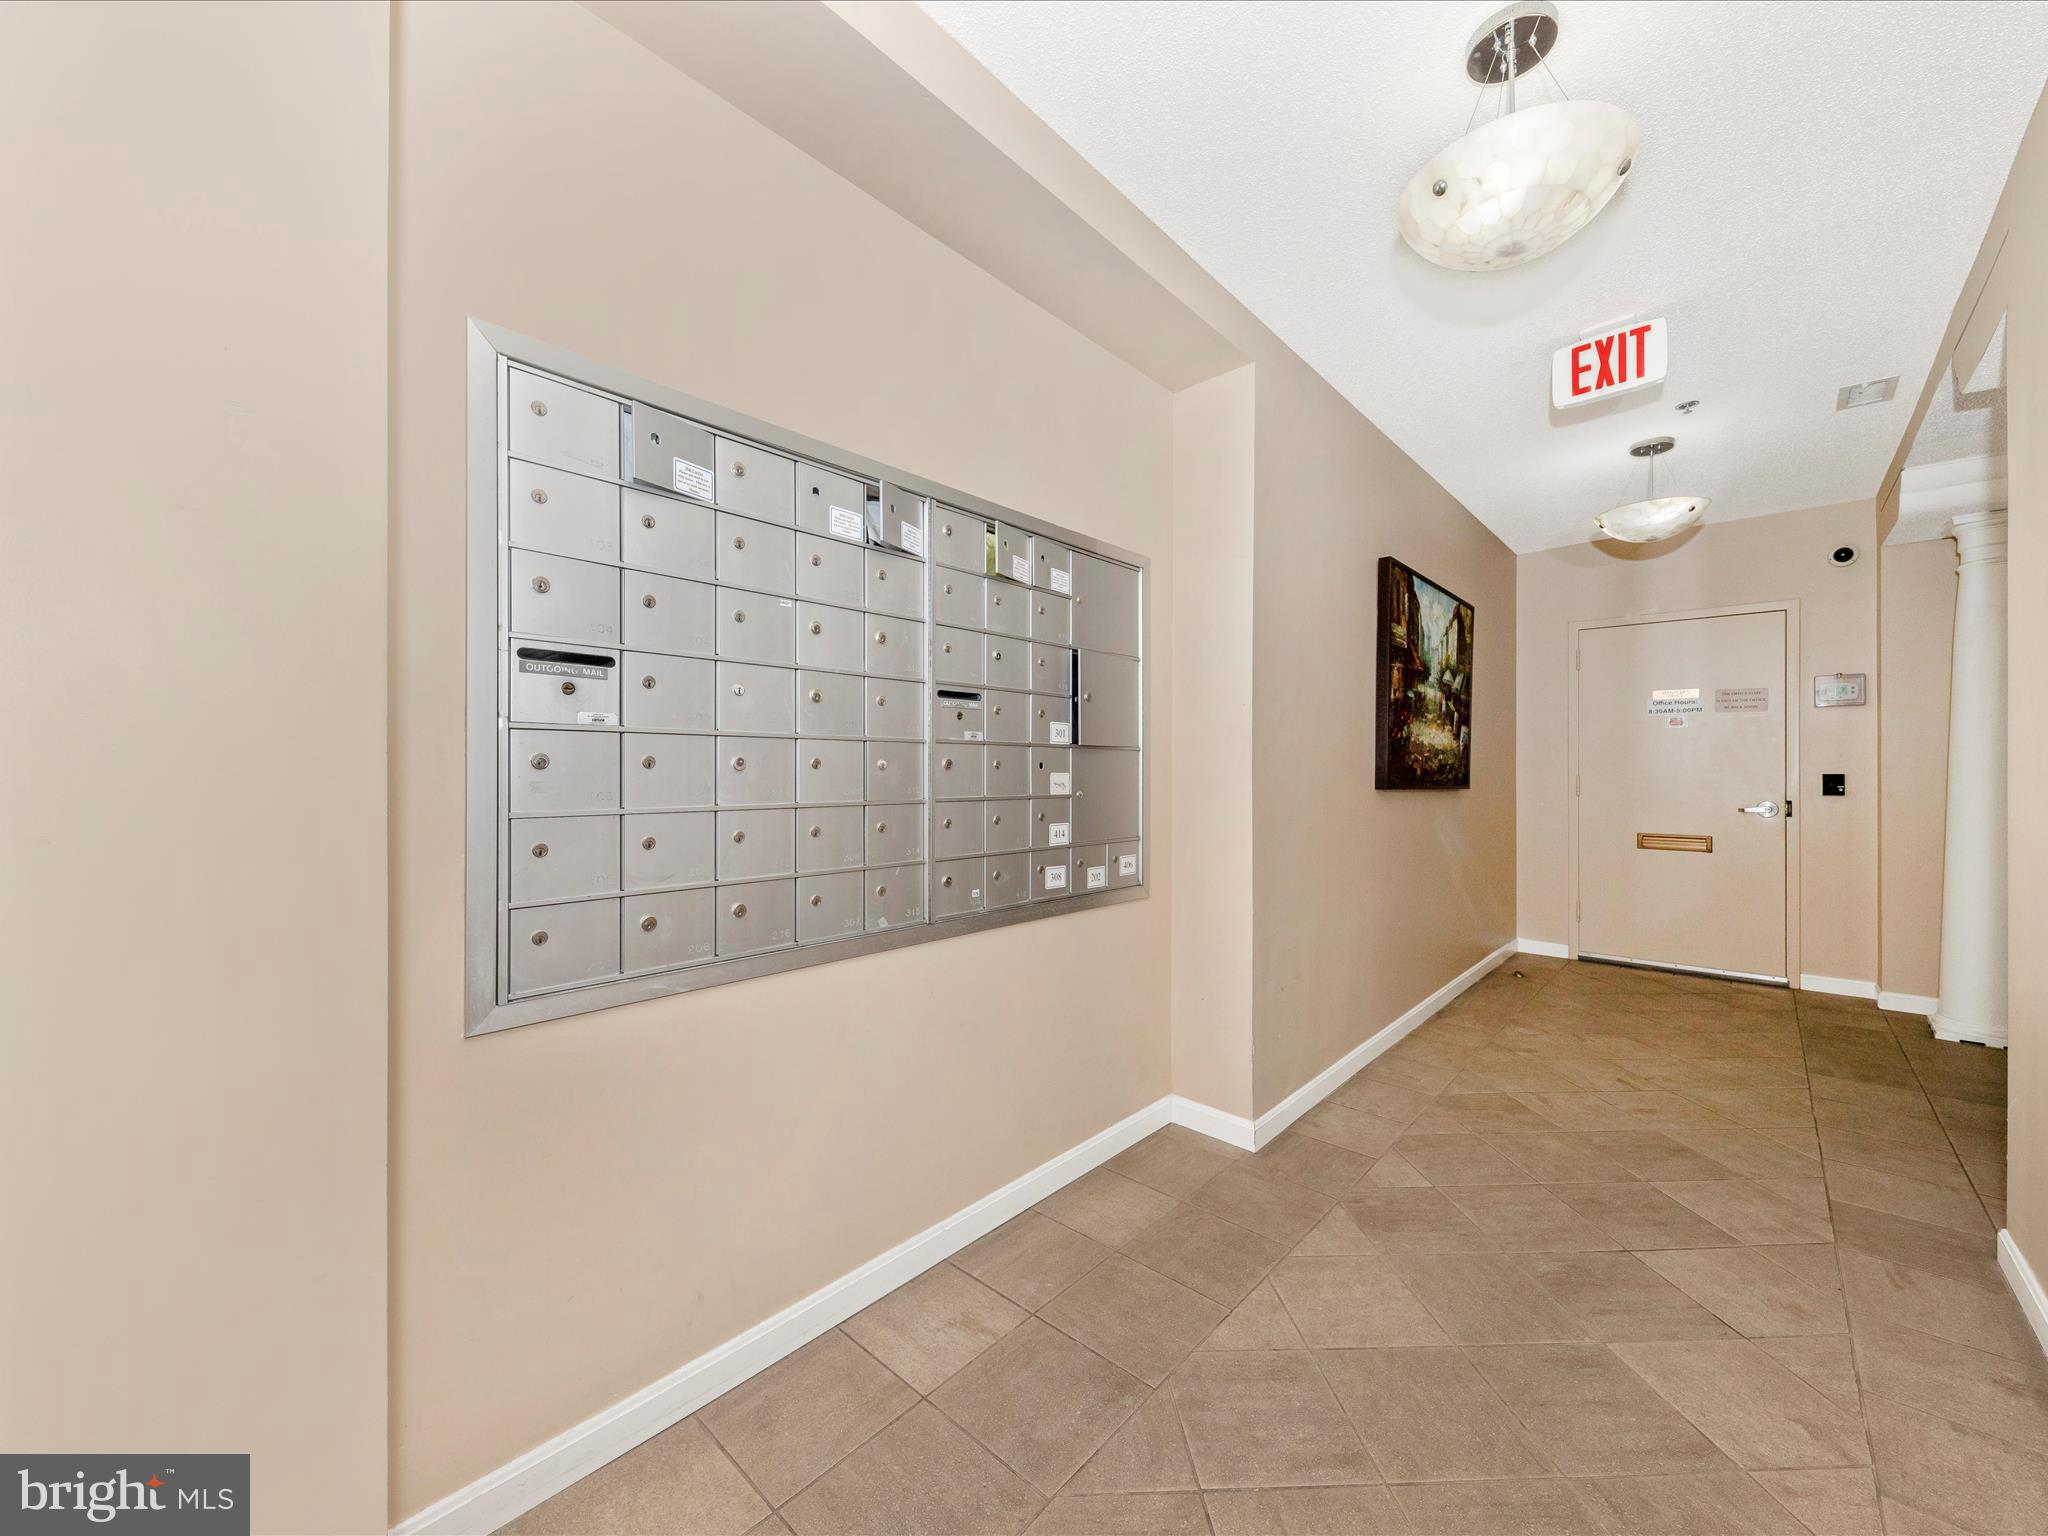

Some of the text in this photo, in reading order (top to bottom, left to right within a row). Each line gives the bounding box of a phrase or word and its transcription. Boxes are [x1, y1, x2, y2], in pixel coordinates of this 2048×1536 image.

[1571, 324, 1651, 397] EXIT
[582, 668, 604, 677] MAIL
[1648, 706, 1703, 714] 8:30AM-500PM
[1055, 729, 1066, 738] 301
[1053, 829, 1065, 839] 414
[1123, 861, 1134, 869] 406
[1050, 872, 1062, 881] 308
[1090, 872, 1101, 881] 202
